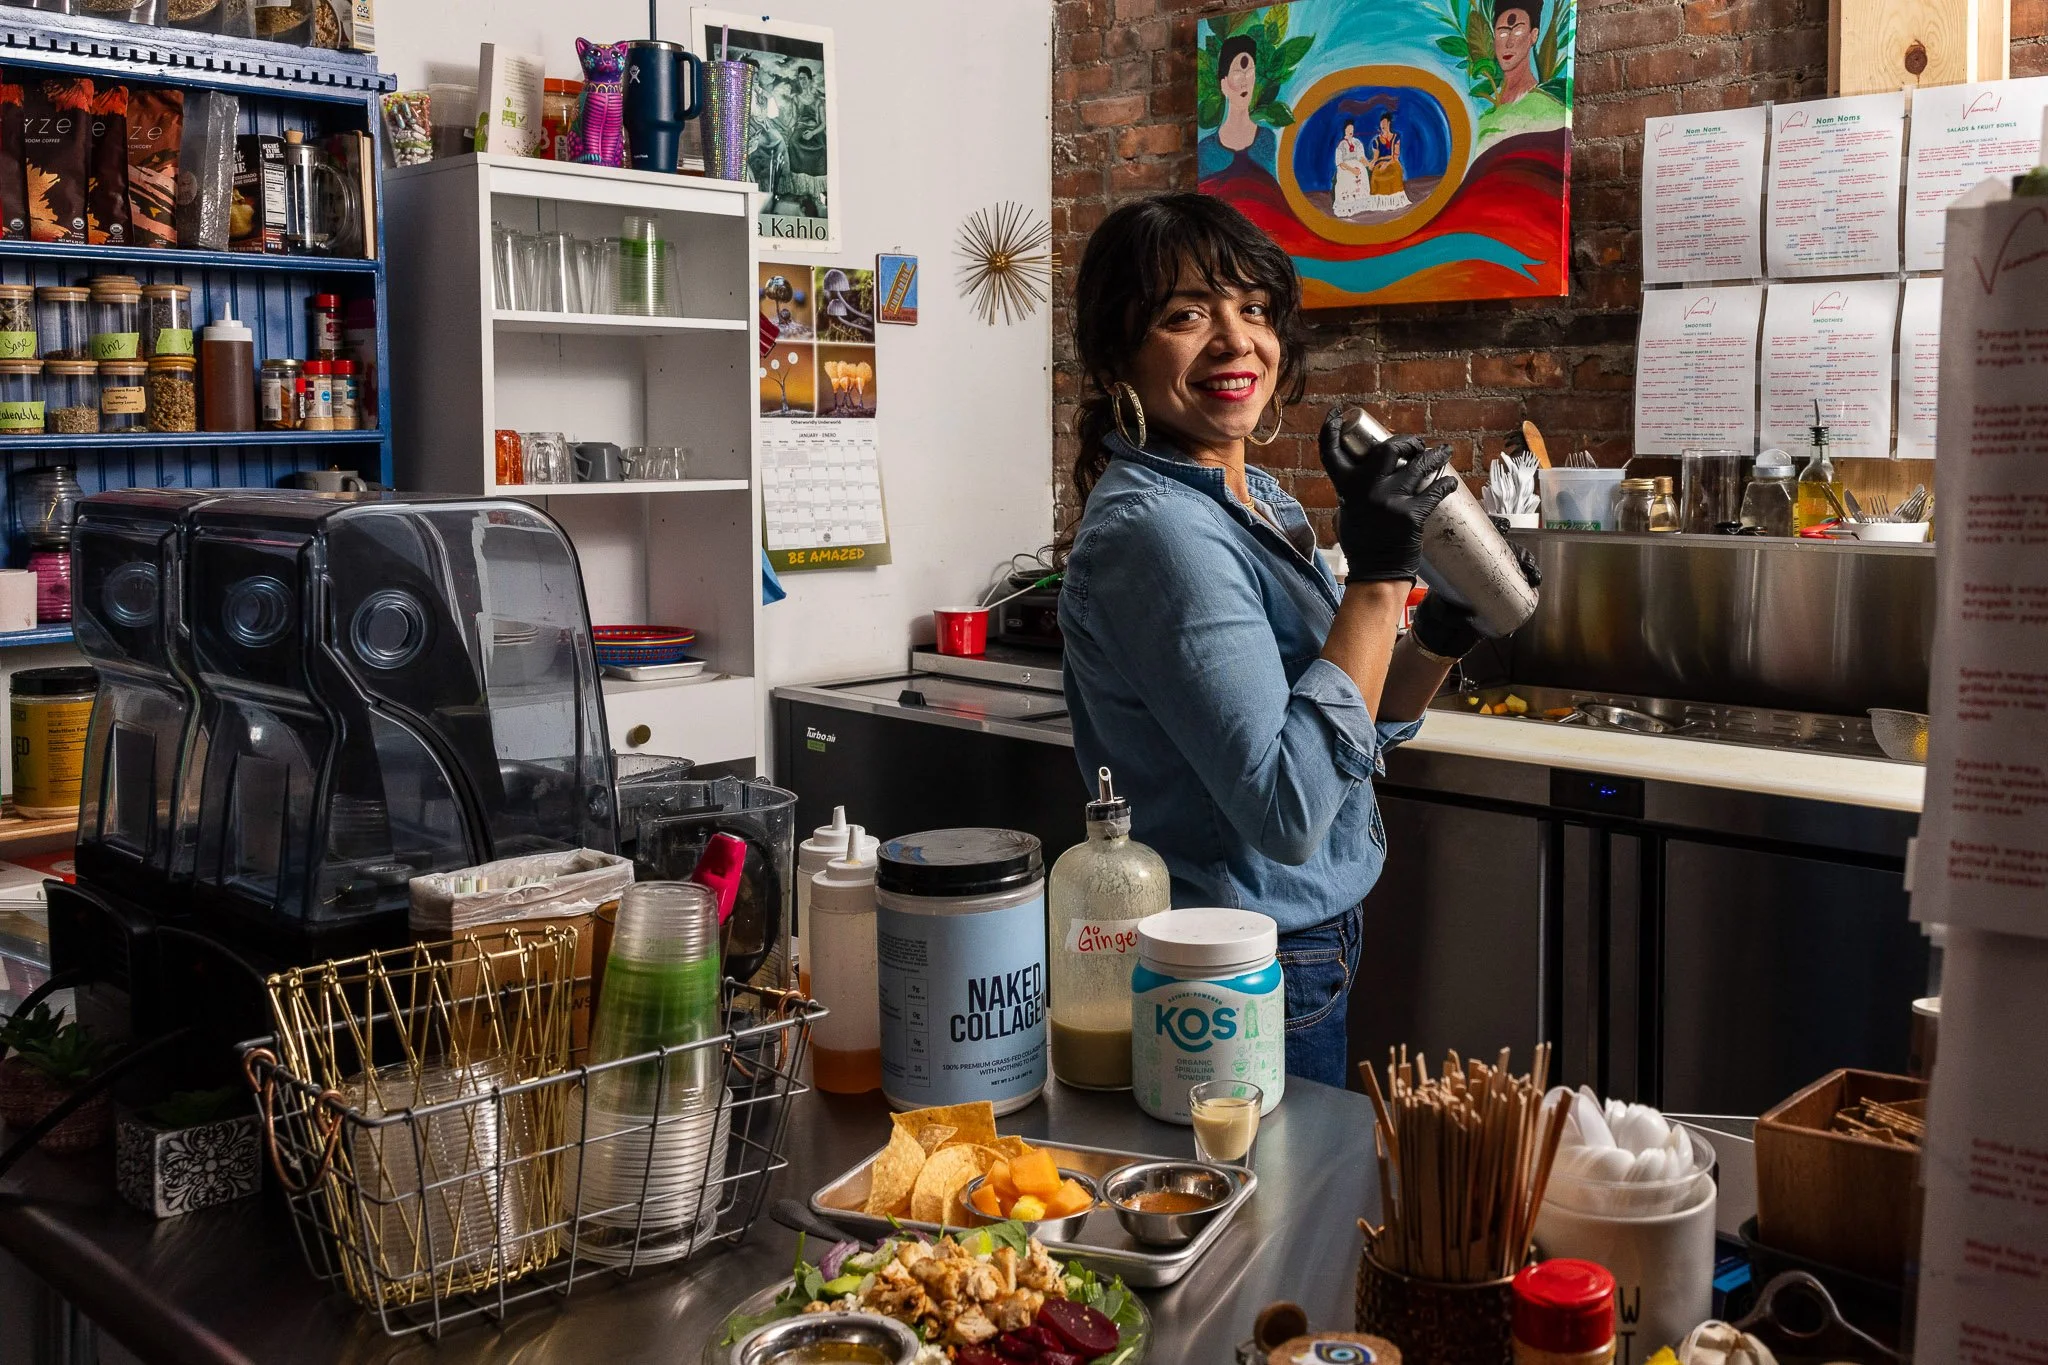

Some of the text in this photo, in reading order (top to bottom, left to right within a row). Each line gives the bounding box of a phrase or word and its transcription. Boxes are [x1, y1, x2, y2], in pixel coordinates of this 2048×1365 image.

[1816, 117, 1834, 125] Nom
[1837, 114, 1861, 122] Noms
[771, 217, 827, 241] Kahlo
[5, 337, 32, 355] Sage
[787, 548, 865, 564] BE AMAZED
[806, 726, 836, 743] Turbo air
[912, 985, 920, 994] 9g
[968, 961, 1041, 1014] NAKED
[950, 989, 1046, 1043] COLLAGEN
[1155, 1003, 1238, 1053] KOS
[942, 1063, 960, 1071] 100%
[960, 1061, 991, 1070] PREMIUM
[991, 1054, 1022, 1067] GRASS-FED
[979, 1067, 997, 1076] WITH
[997, 1061, 1023, 1073] NOTHING
[1174, 1066, 1215, 1074] SPIRULINA
[1619, 1286, 1641, 1324] W
